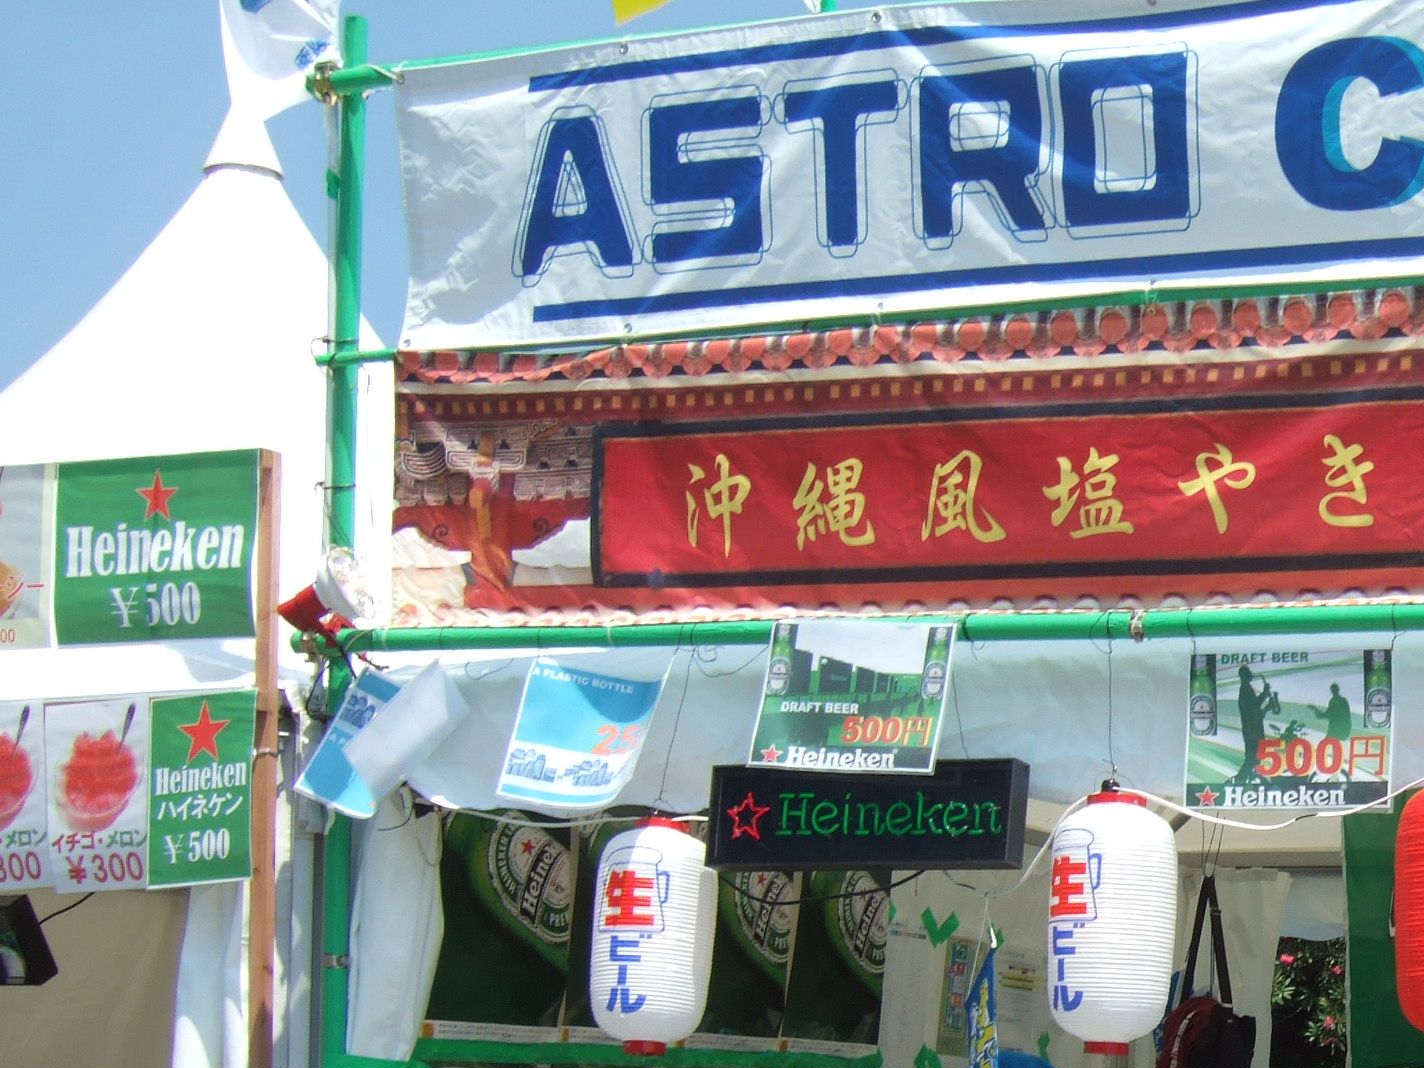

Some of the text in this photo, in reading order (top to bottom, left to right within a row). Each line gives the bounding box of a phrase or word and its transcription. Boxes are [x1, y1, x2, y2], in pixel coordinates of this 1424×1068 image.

[514, 42, 1200, 287] ASTRO
[65, 519, 245, 579] Heineken
[110, 581, 202, 629] ¥500
[1220, 651, 1309, 665] DRAFT BEER
[592, 679, 635, 694] BOTTLE
[780, 700, 860, 715] DRAFT BEER
[841, 714, 934, 747] 500円
[785, 745, 897, 769] Heineken
[1254, 735, 1387, 777] 500円
[155, 759, 247, 796] Heineken
[1222, 784, 1347, 807] Heineken
[156, 791, 243, 821] ハイネケン
[774, 789, 1003, 838] Heineken
[52, 827, 149, 854] イチゴ・メロン
[163, 827, 231, 865] ¥500
[67, 849, 145, 885] ¥300
[604, 869, 656, 1014] 生ビール
[1049, 854, 1088, 1013] 生ビール
